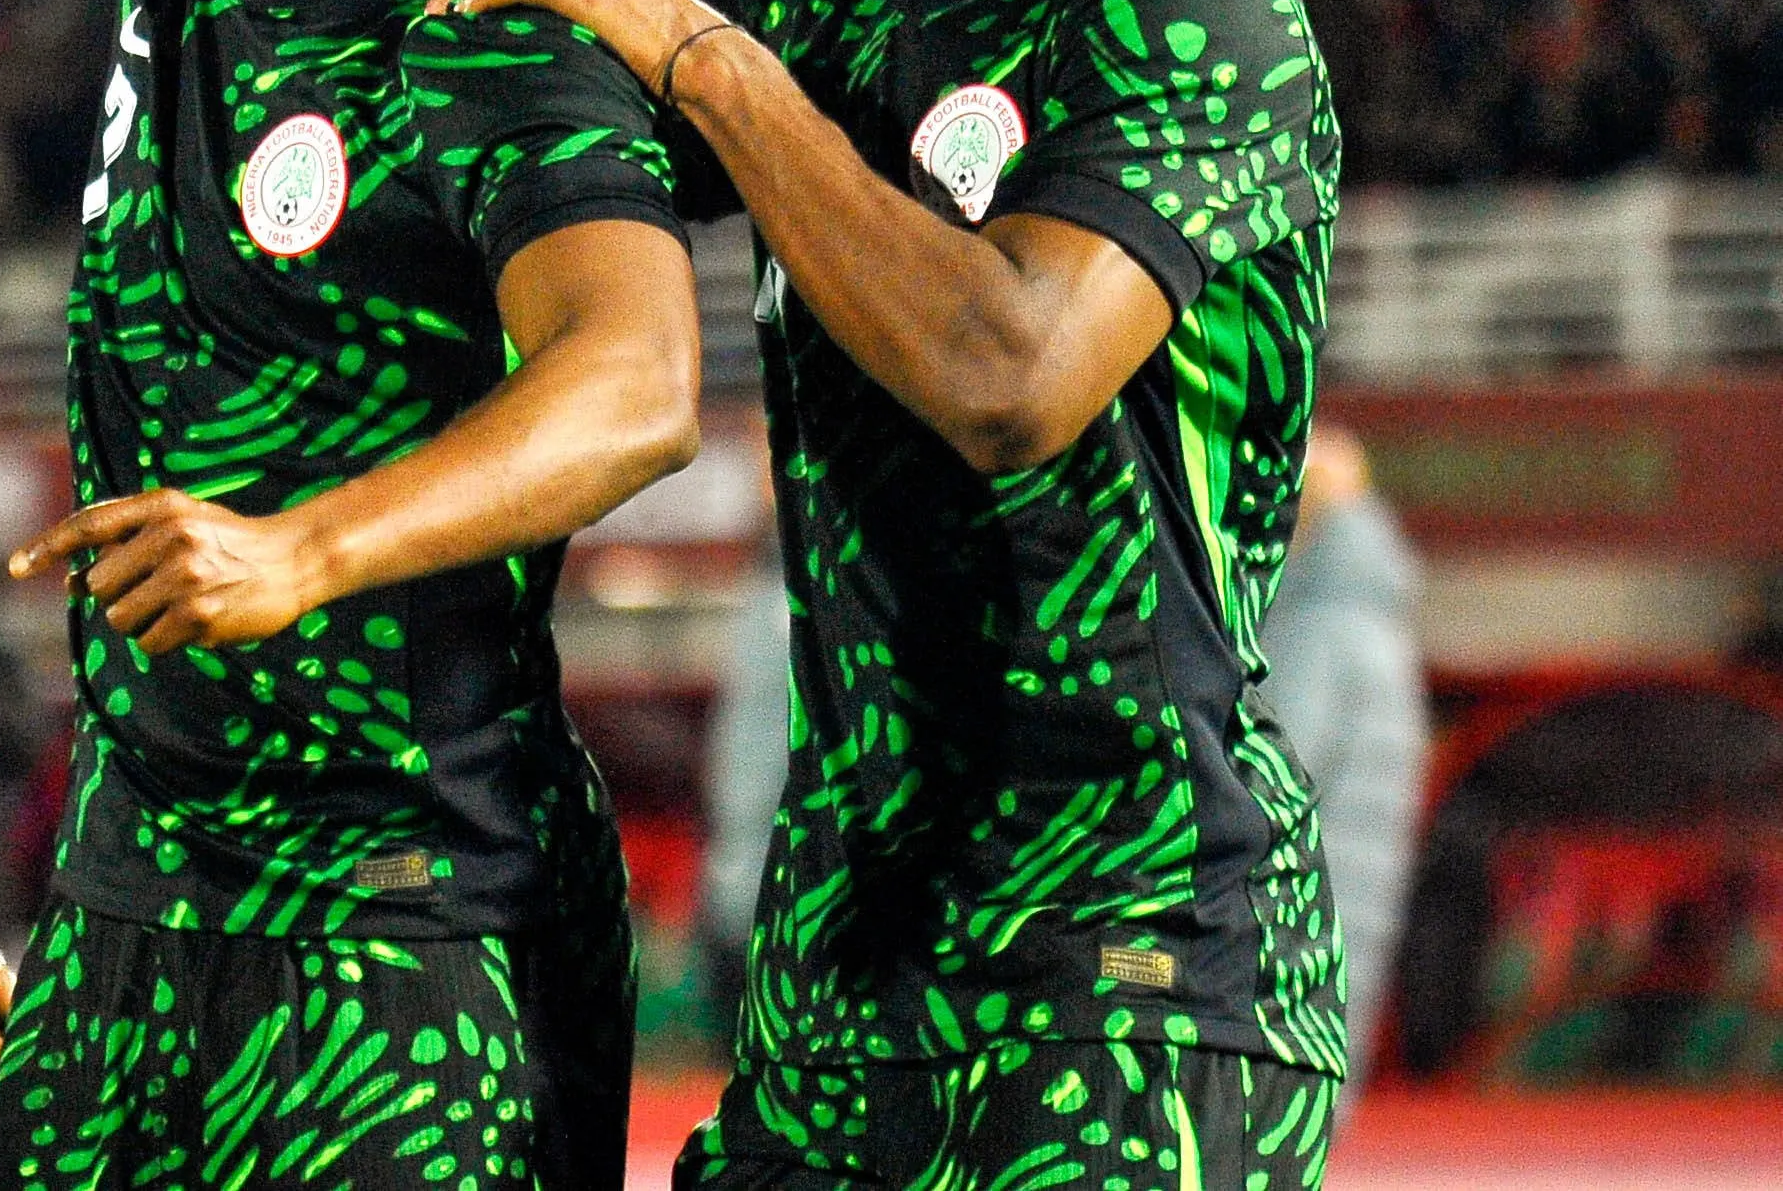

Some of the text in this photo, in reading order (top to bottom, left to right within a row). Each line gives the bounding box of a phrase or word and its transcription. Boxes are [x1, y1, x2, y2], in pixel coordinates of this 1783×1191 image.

[927, 93, 992, 132] FOOTBALL
[246, 122, 339, 235] NIGERIA FOOTBALL FEDERATION
[266, 230, 293, 245] 1945
